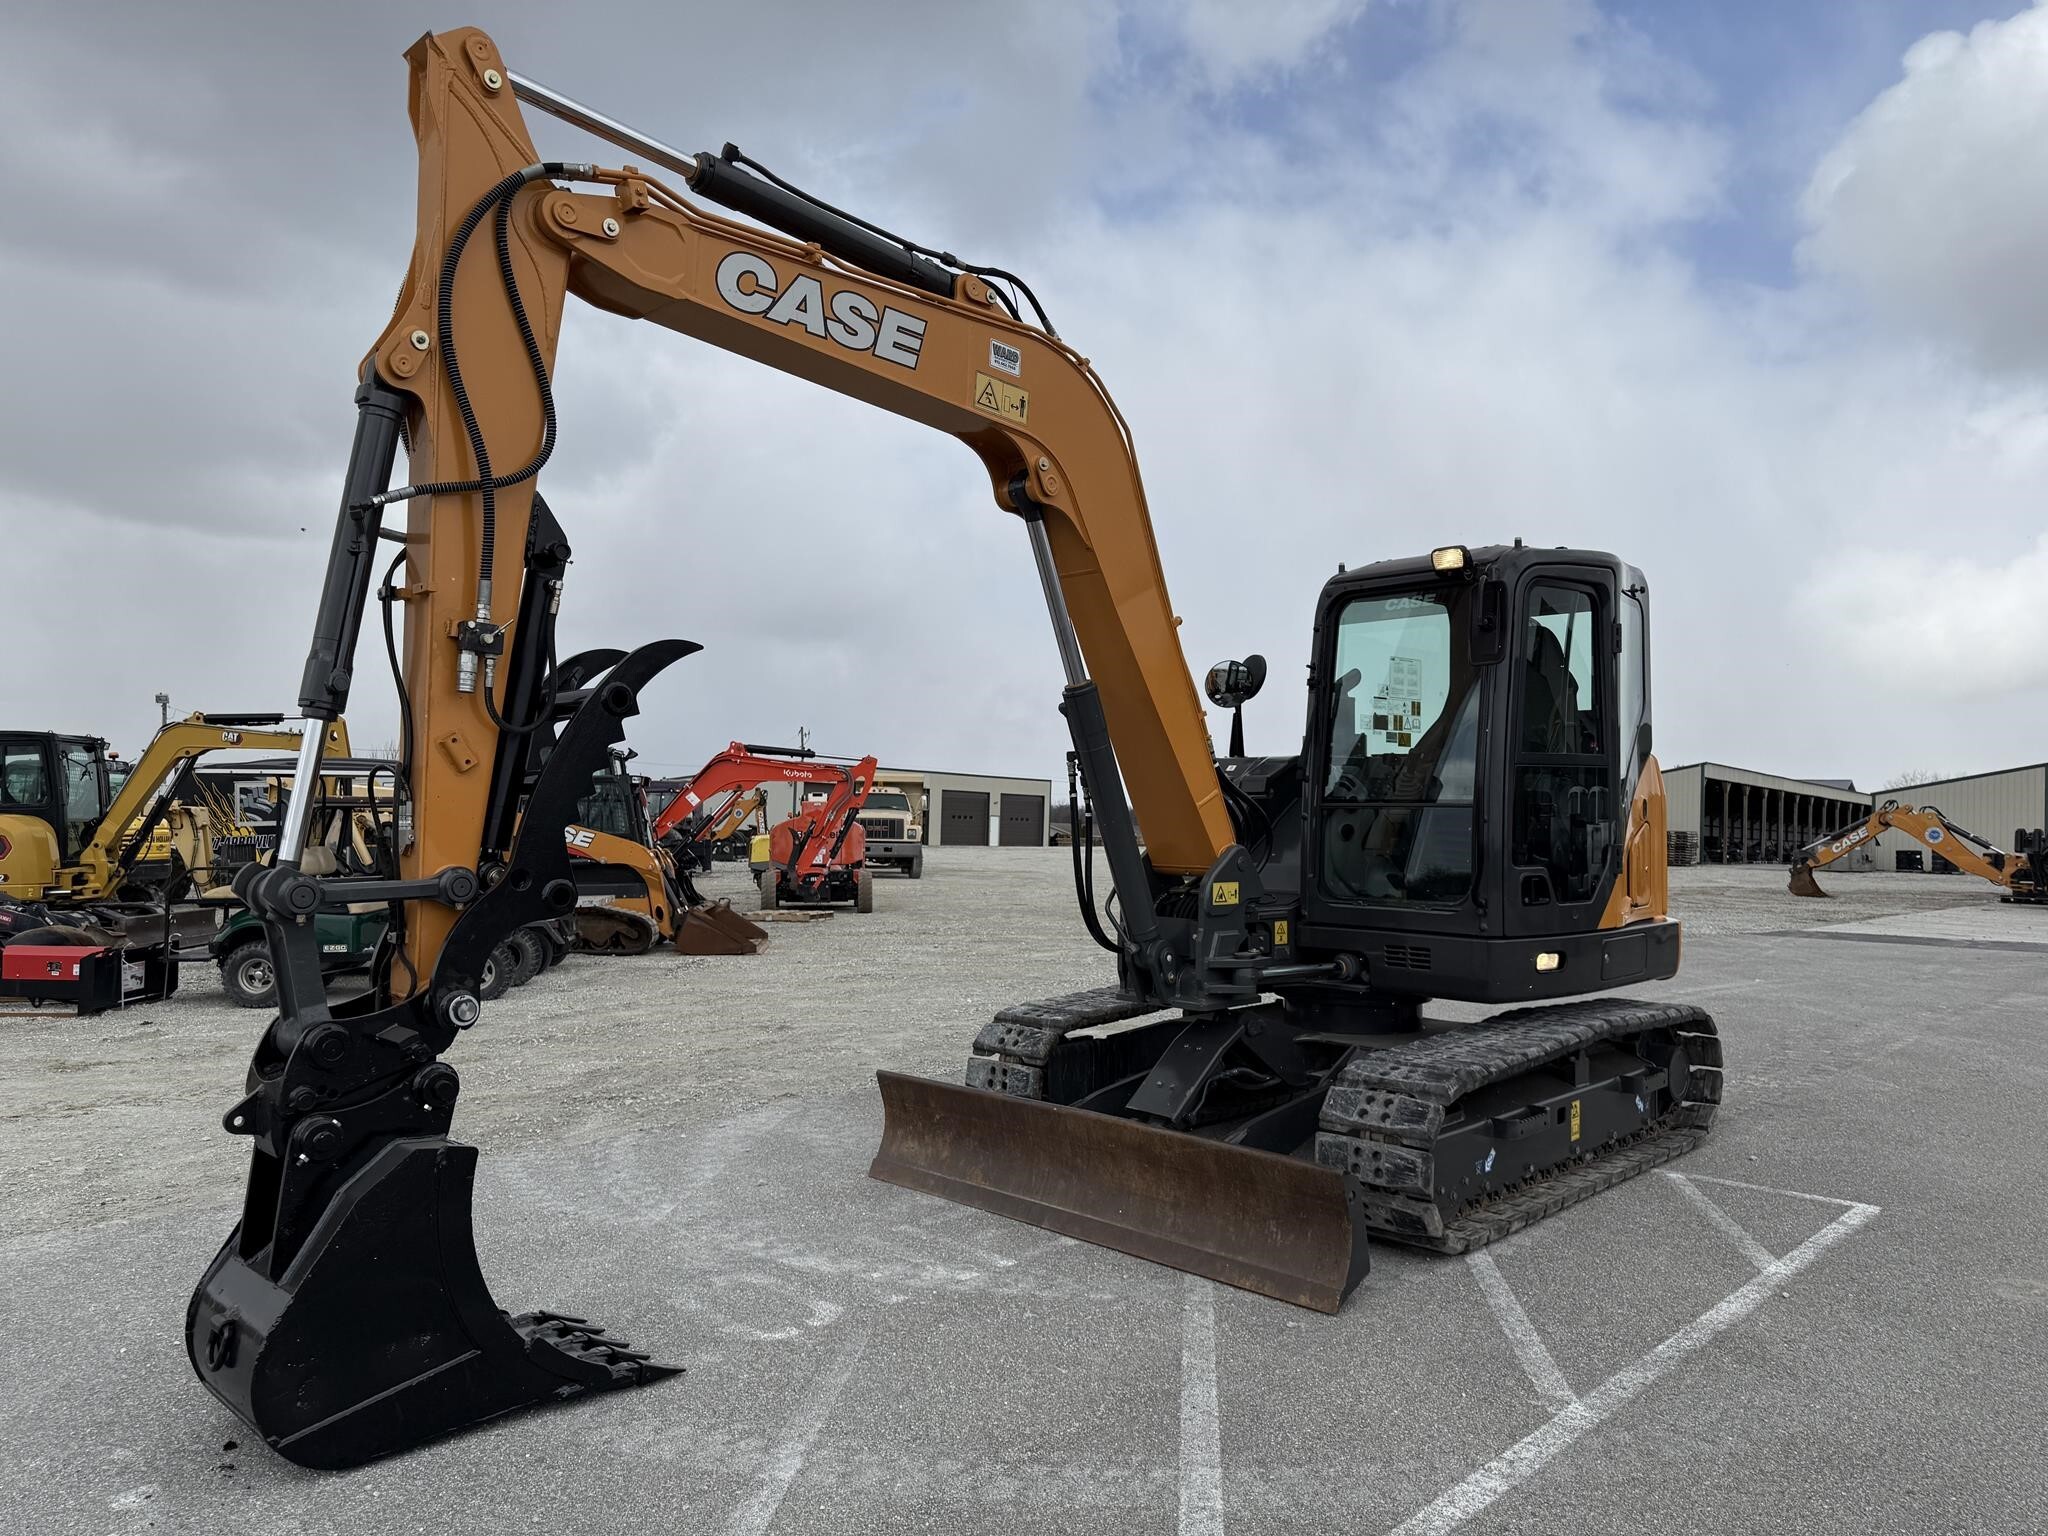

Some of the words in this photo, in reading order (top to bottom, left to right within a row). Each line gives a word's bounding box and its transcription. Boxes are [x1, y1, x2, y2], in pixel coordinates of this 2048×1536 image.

[715, 251, 928, 370] CASE
[1385, 593, 1436, 610] CASE
[222, 731, 239, 742] CAT
[783, 769, 812, 778] Kubota
[565, 827, 596, 848] SE
[1832, 826, 1868, 853] CASE
